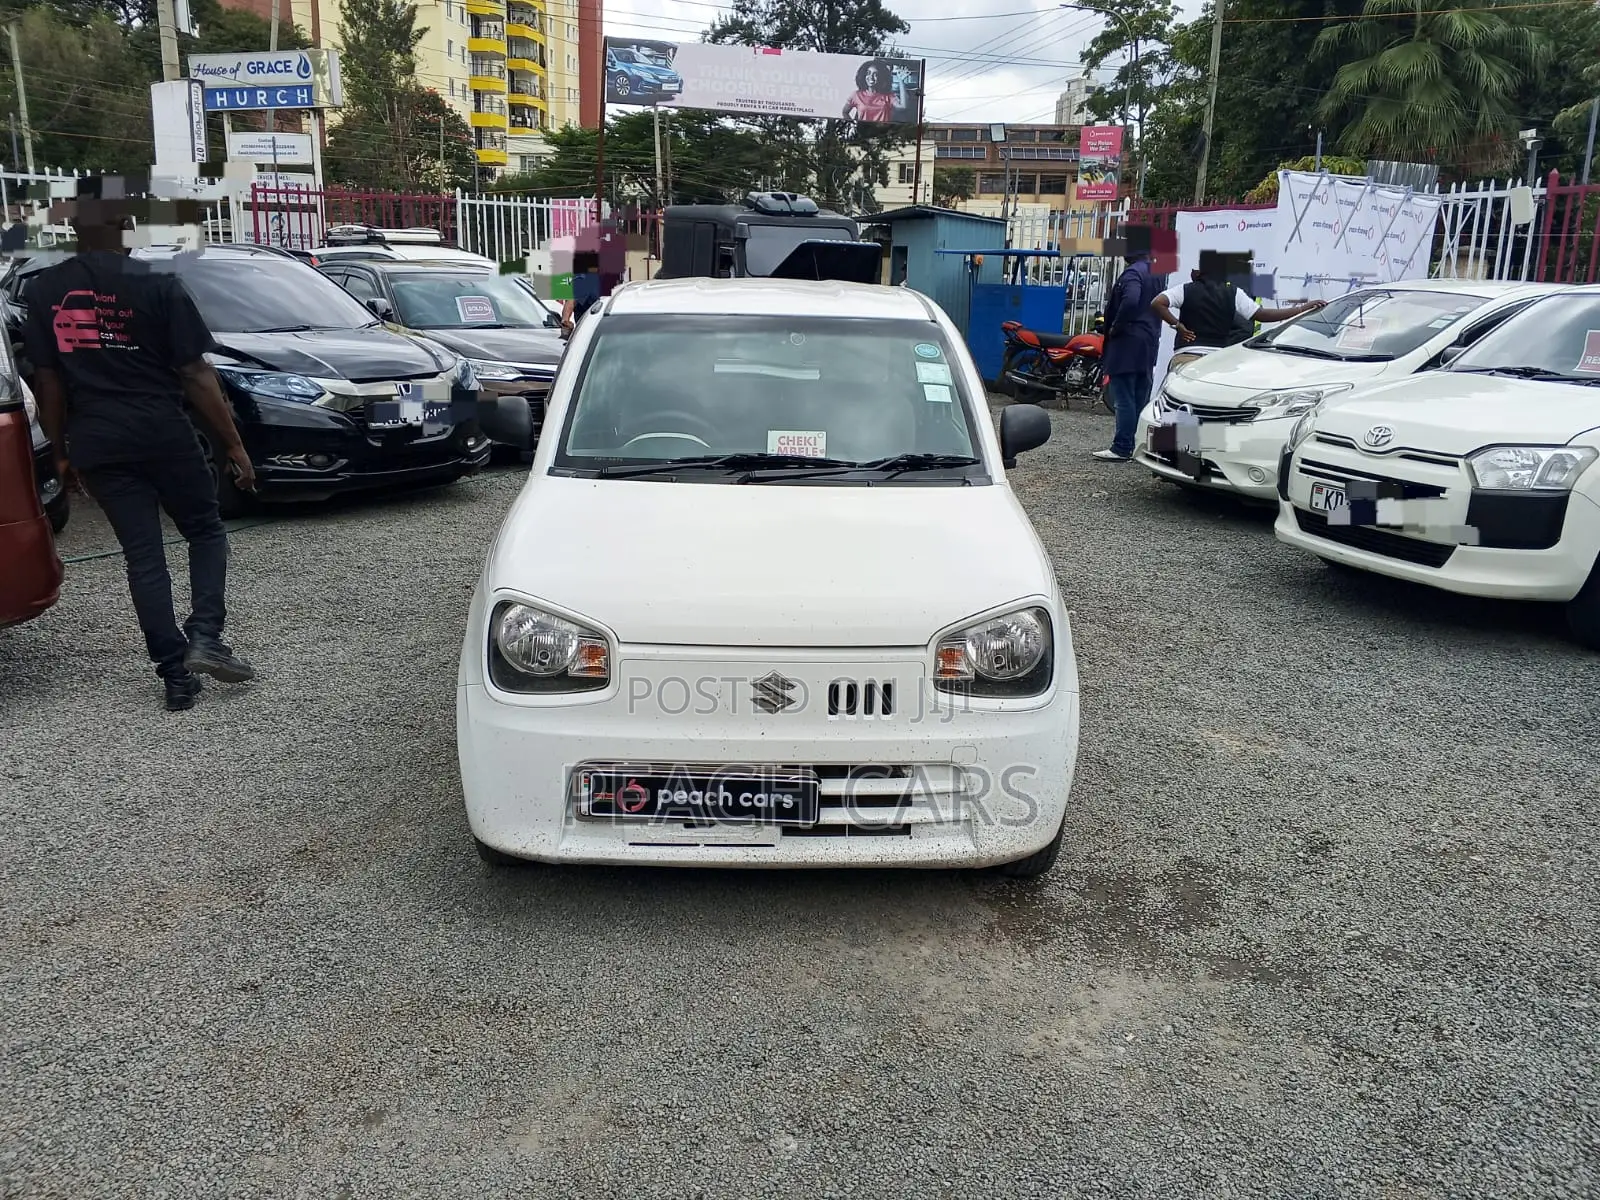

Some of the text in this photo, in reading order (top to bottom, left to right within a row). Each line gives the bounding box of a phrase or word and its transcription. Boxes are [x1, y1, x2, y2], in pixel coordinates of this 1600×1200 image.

[193, 60, 293, 80] House of GRACE
[698, 64, 831, 87] THANK YOU FOR
[216, 88, 309, 107] HURCH
[686, 78, 777, 97] CHOOSING
[780, 85, 839, 101] PEACH!
[1246, 220, 1260, 230] peach
[777, 435, 817, 447] CHEKI
[776, 446, 819, 457] MBELE
[657, 784, 795, 811] peach cars
